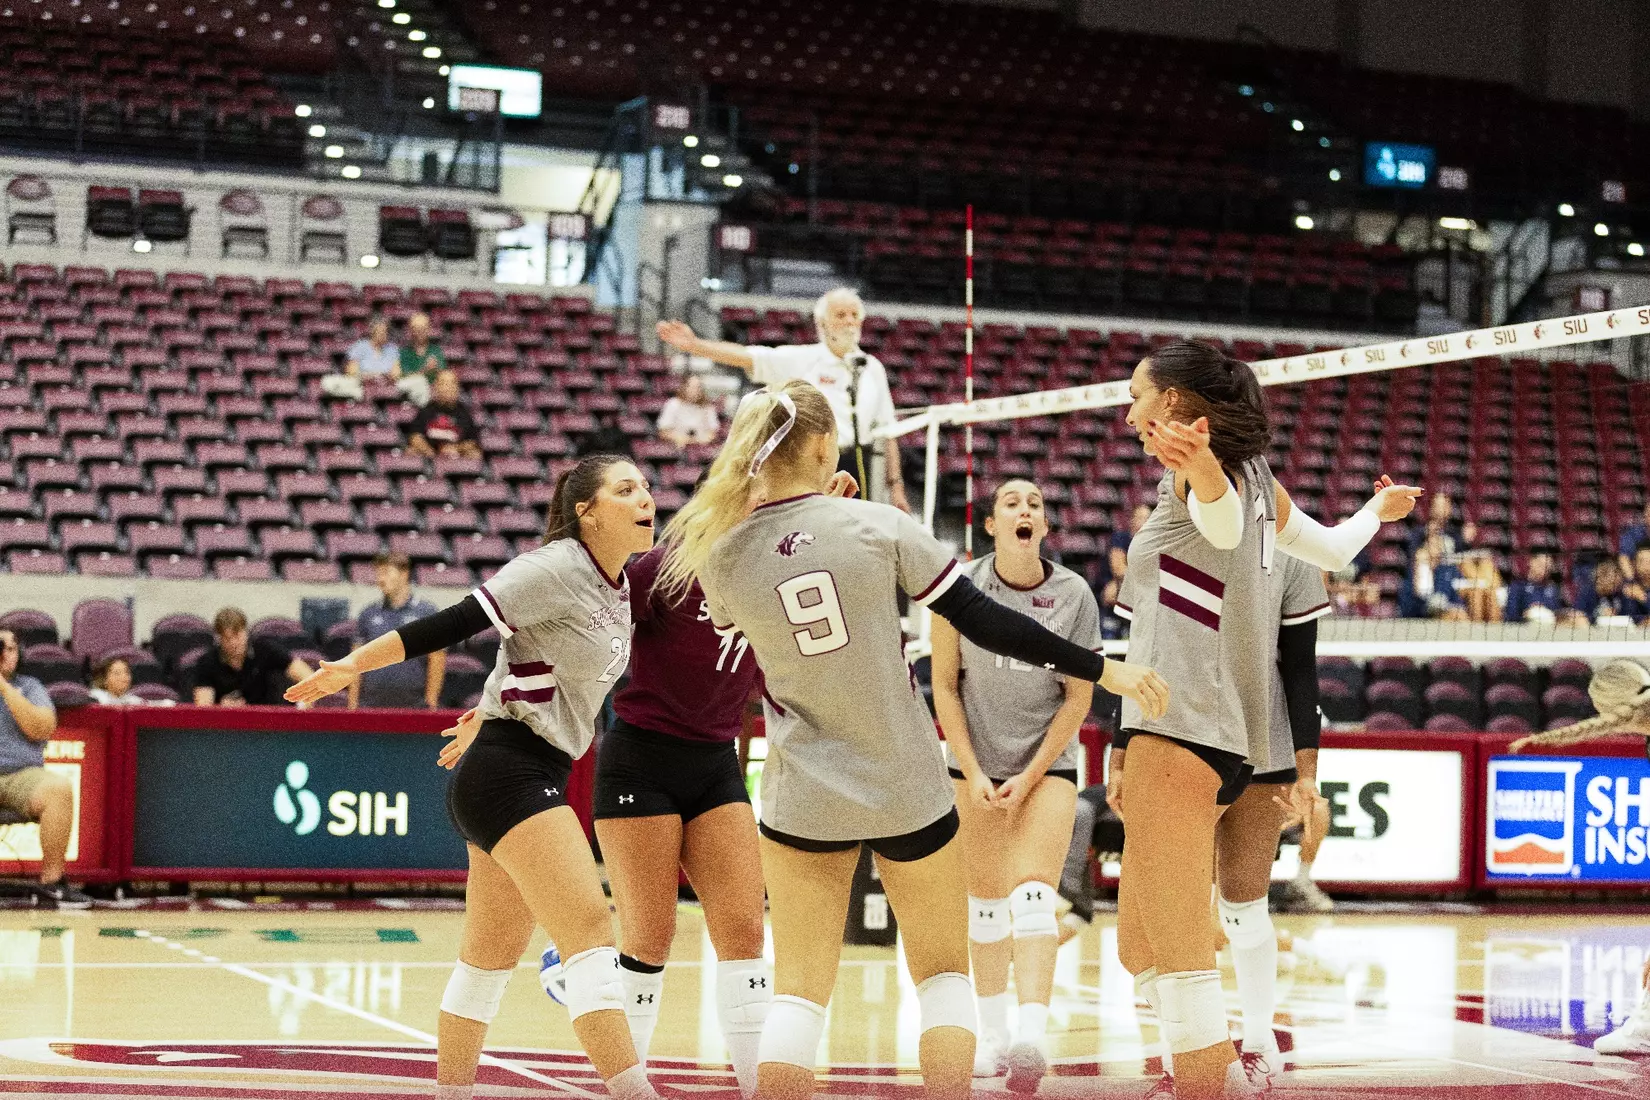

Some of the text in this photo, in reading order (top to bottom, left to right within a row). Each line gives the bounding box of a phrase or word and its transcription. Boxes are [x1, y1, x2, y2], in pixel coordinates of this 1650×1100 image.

[1306, 357, 1326, 372] SIU
[1365, 348, 1386, 364] SIU
[1427, 340, 1449, 355] SIU
[1494, 329, 1517, 346] SIU
[1563, 318, 1588, 336] SIU
[774, 570, 850, 657] 9
[715, 635, 749, 673] 11
[326, 790, 409, 836] SIH
[1584, 826, 1650, 865] INS
